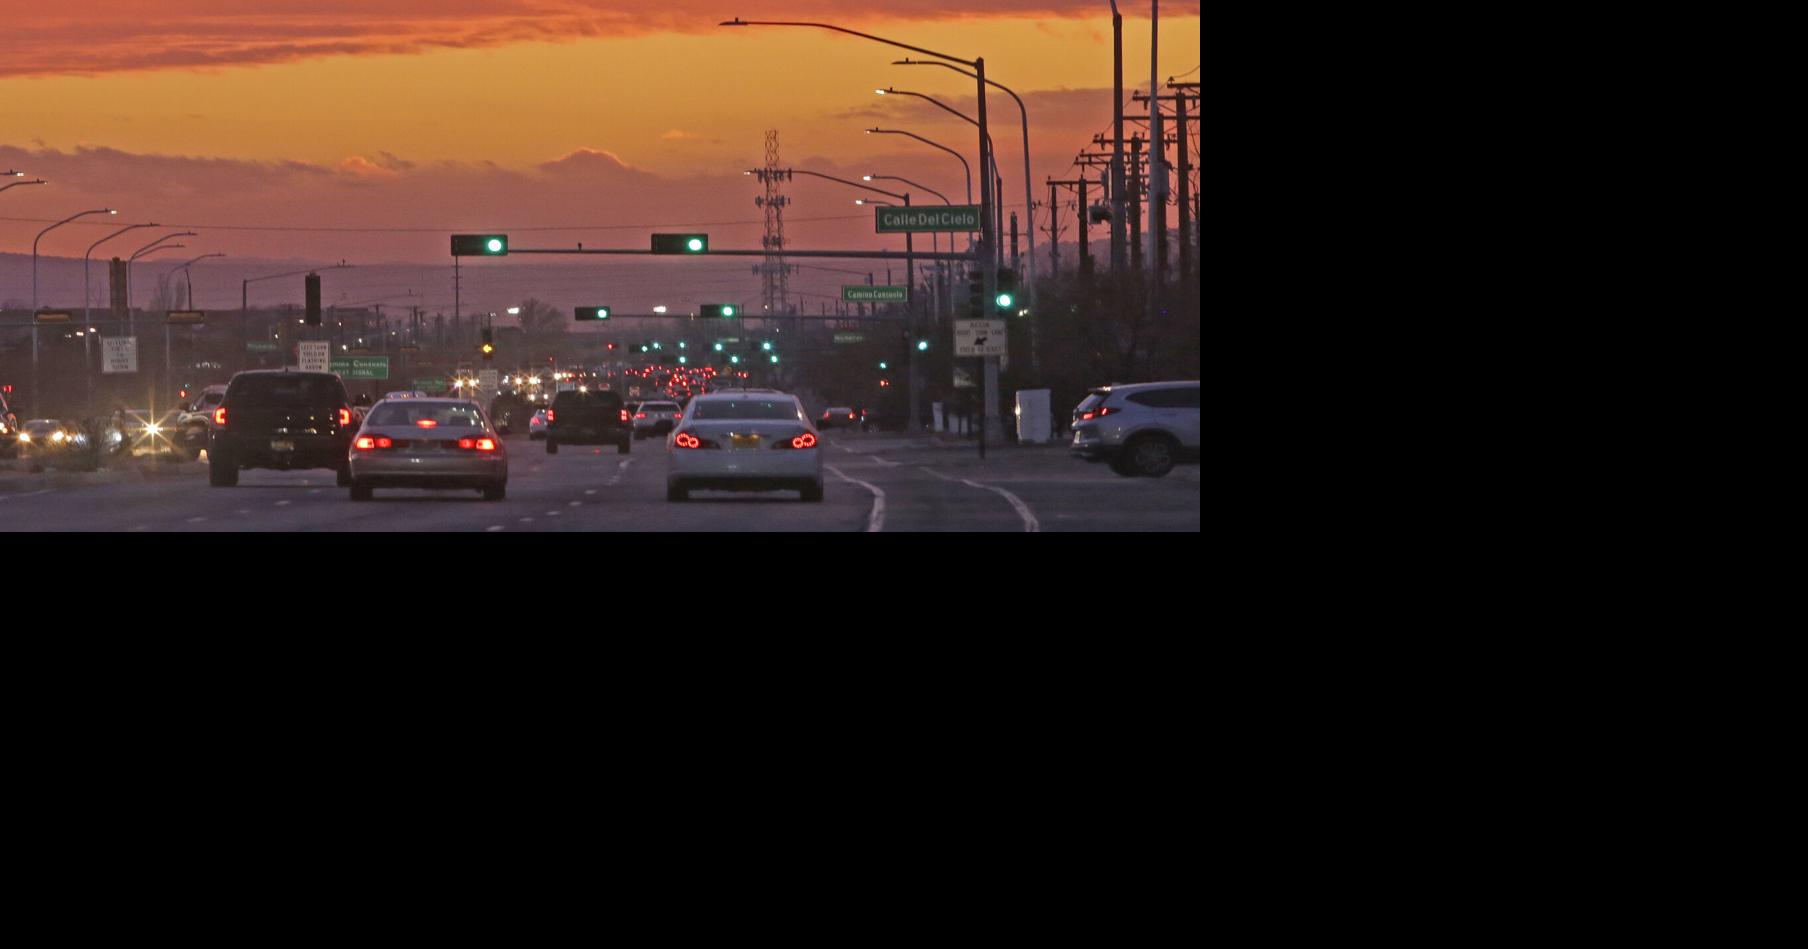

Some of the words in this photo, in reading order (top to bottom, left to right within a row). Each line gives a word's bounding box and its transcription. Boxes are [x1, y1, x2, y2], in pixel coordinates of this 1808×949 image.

[884, 213, 916, 226] Calle
[918, 213, 939, 226] Del
[941, 212, 974, 225] Cielo
[847, 290, 873, 299] Camino
[873, 290, 903, 299] Consuelo
